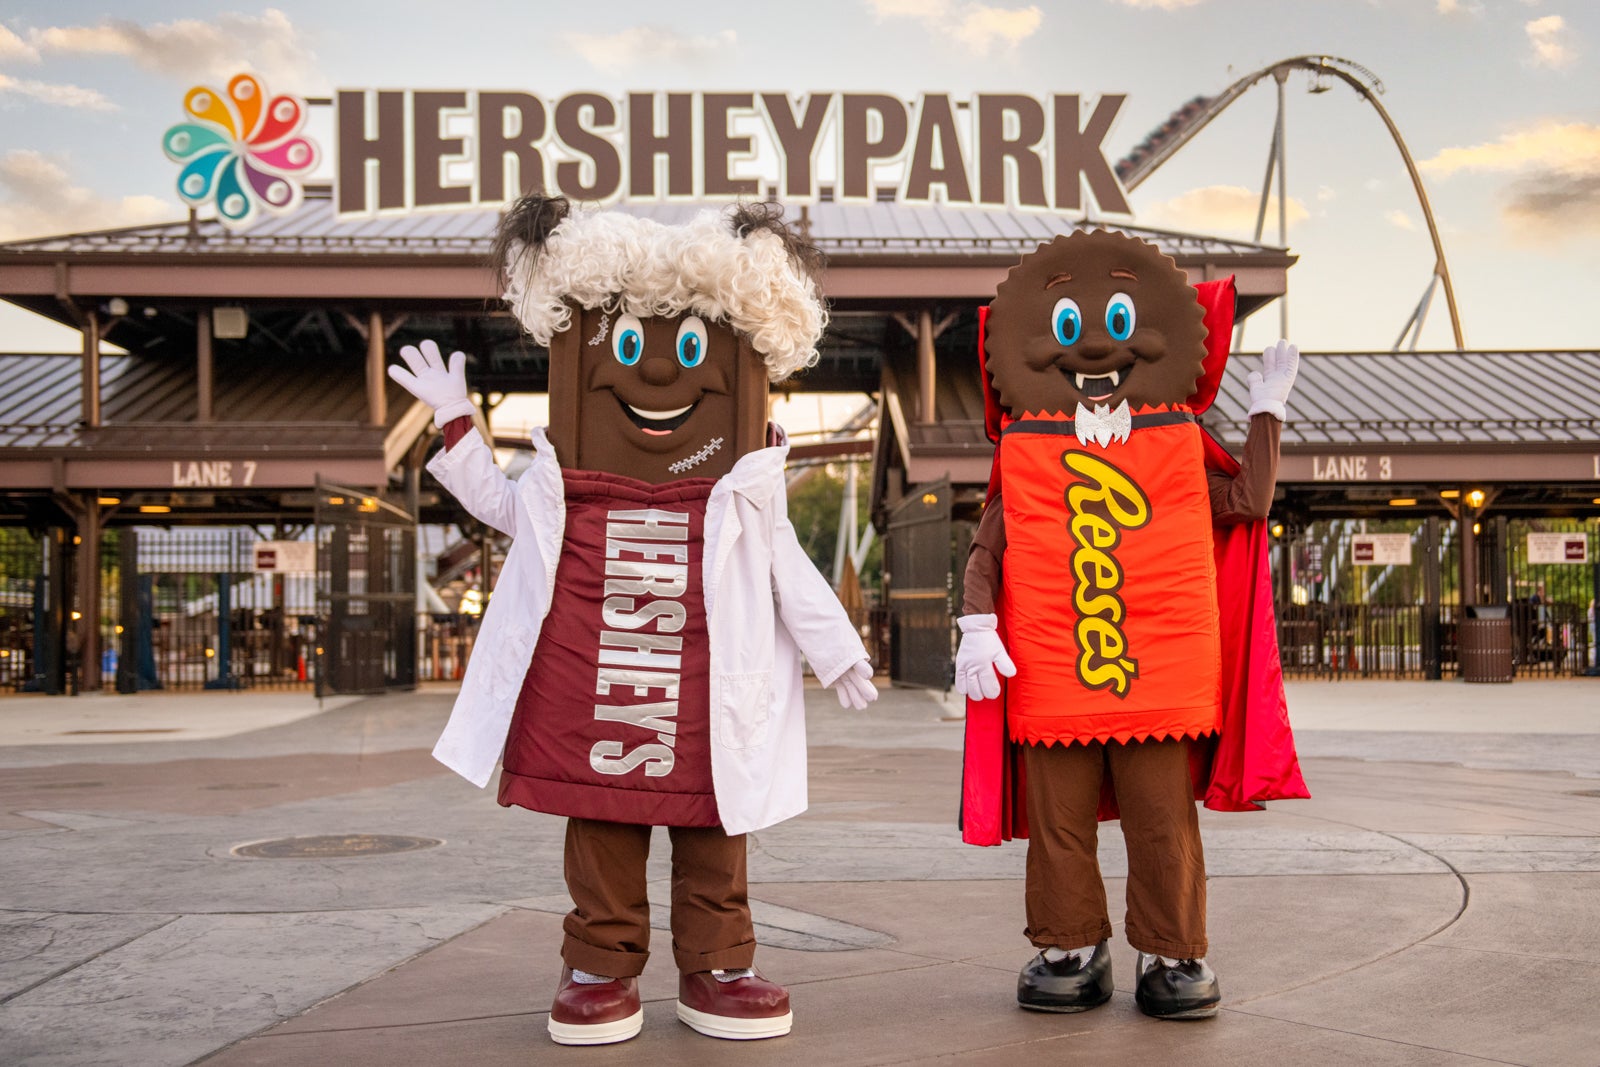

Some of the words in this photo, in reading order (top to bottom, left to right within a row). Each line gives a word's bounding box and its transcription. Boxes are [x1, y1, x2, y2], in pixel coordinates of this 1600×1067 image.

[336, 88, 1133, 218] HERSHEYPARK
[173, 461, 232, 486] LANE
[243, 461, 257, 486] 7
[1313, 455, 1367, 480] LANE
[1379, 455, 1392, 480] 3
[1062, 450, 1151, 698] Reese's
[589, 509, 690, 777] HERSHEY'S
